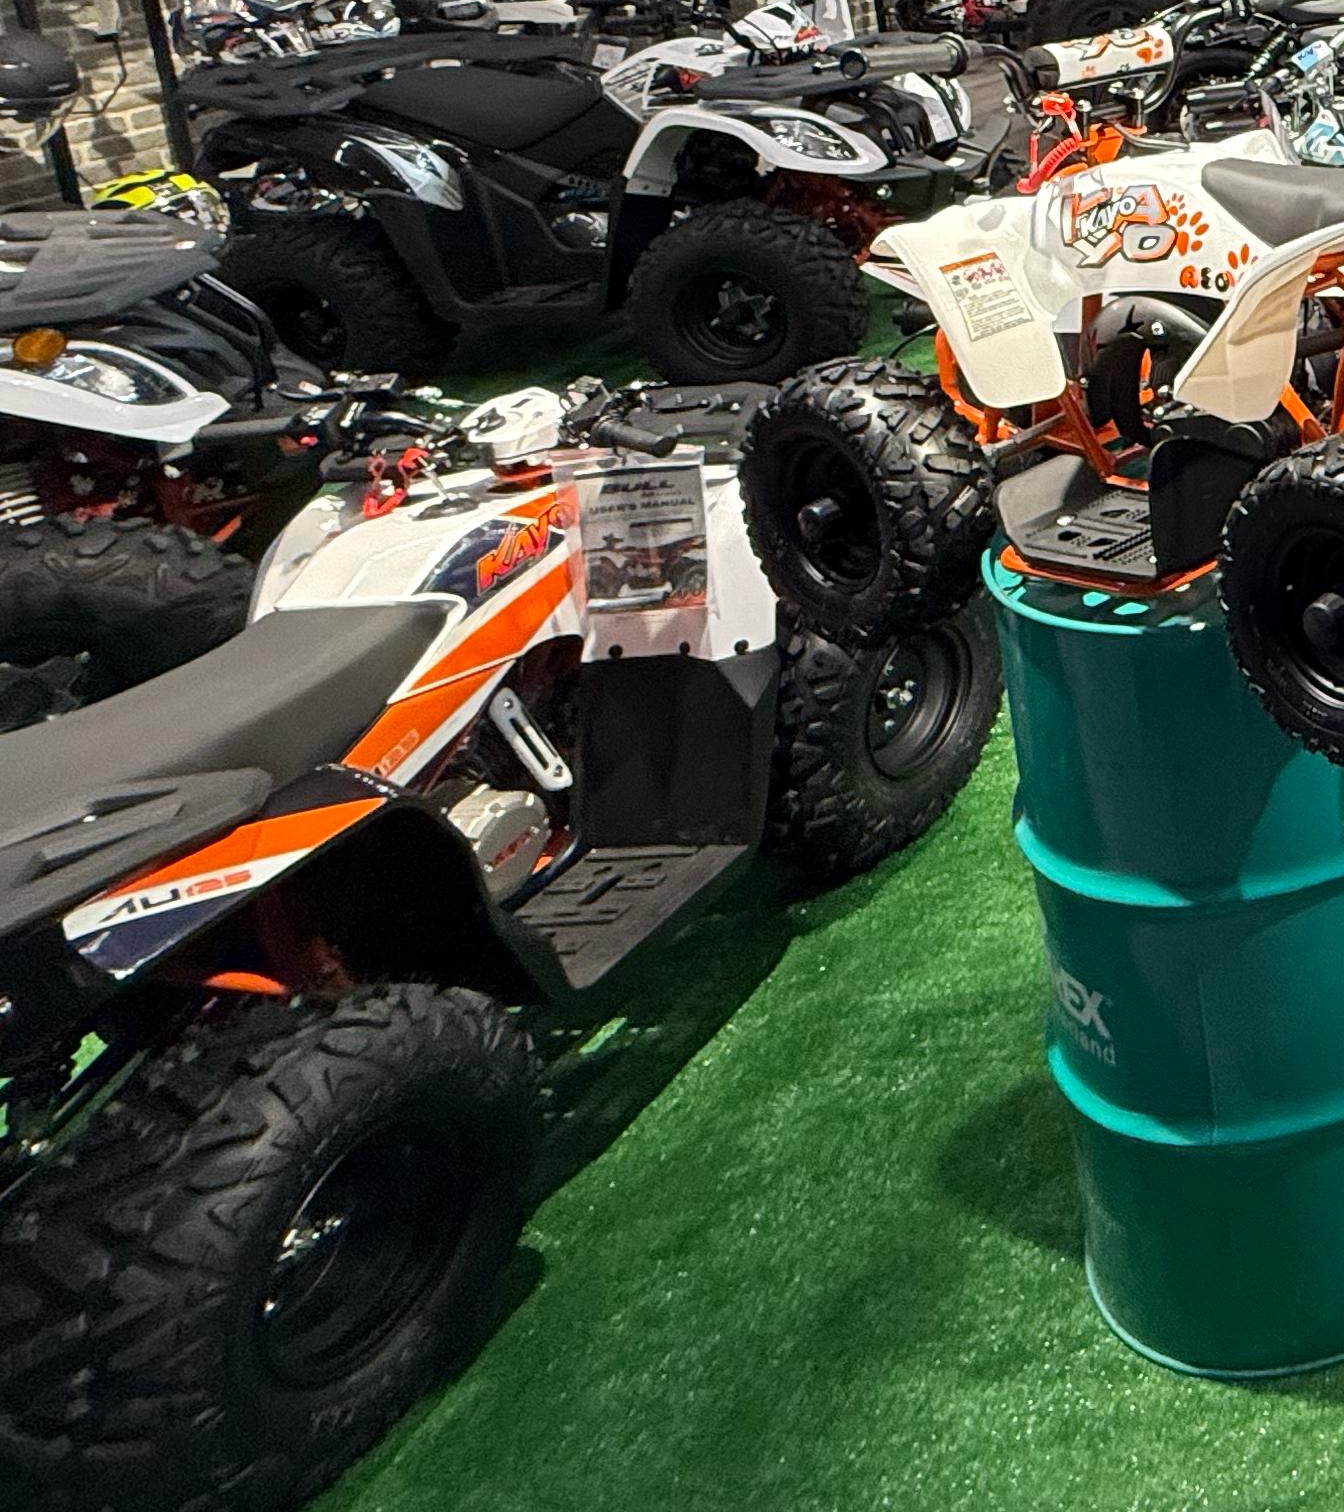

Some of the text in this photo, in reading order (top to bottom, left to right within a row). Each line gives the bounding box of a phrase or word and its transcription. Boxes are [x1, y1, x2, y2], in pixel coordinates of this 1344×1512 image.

[600, 480, 675, 495] BULL
[588, 496, 696, 516] USER'S MANUAL
[476, 502, 576, 597] KAYO
